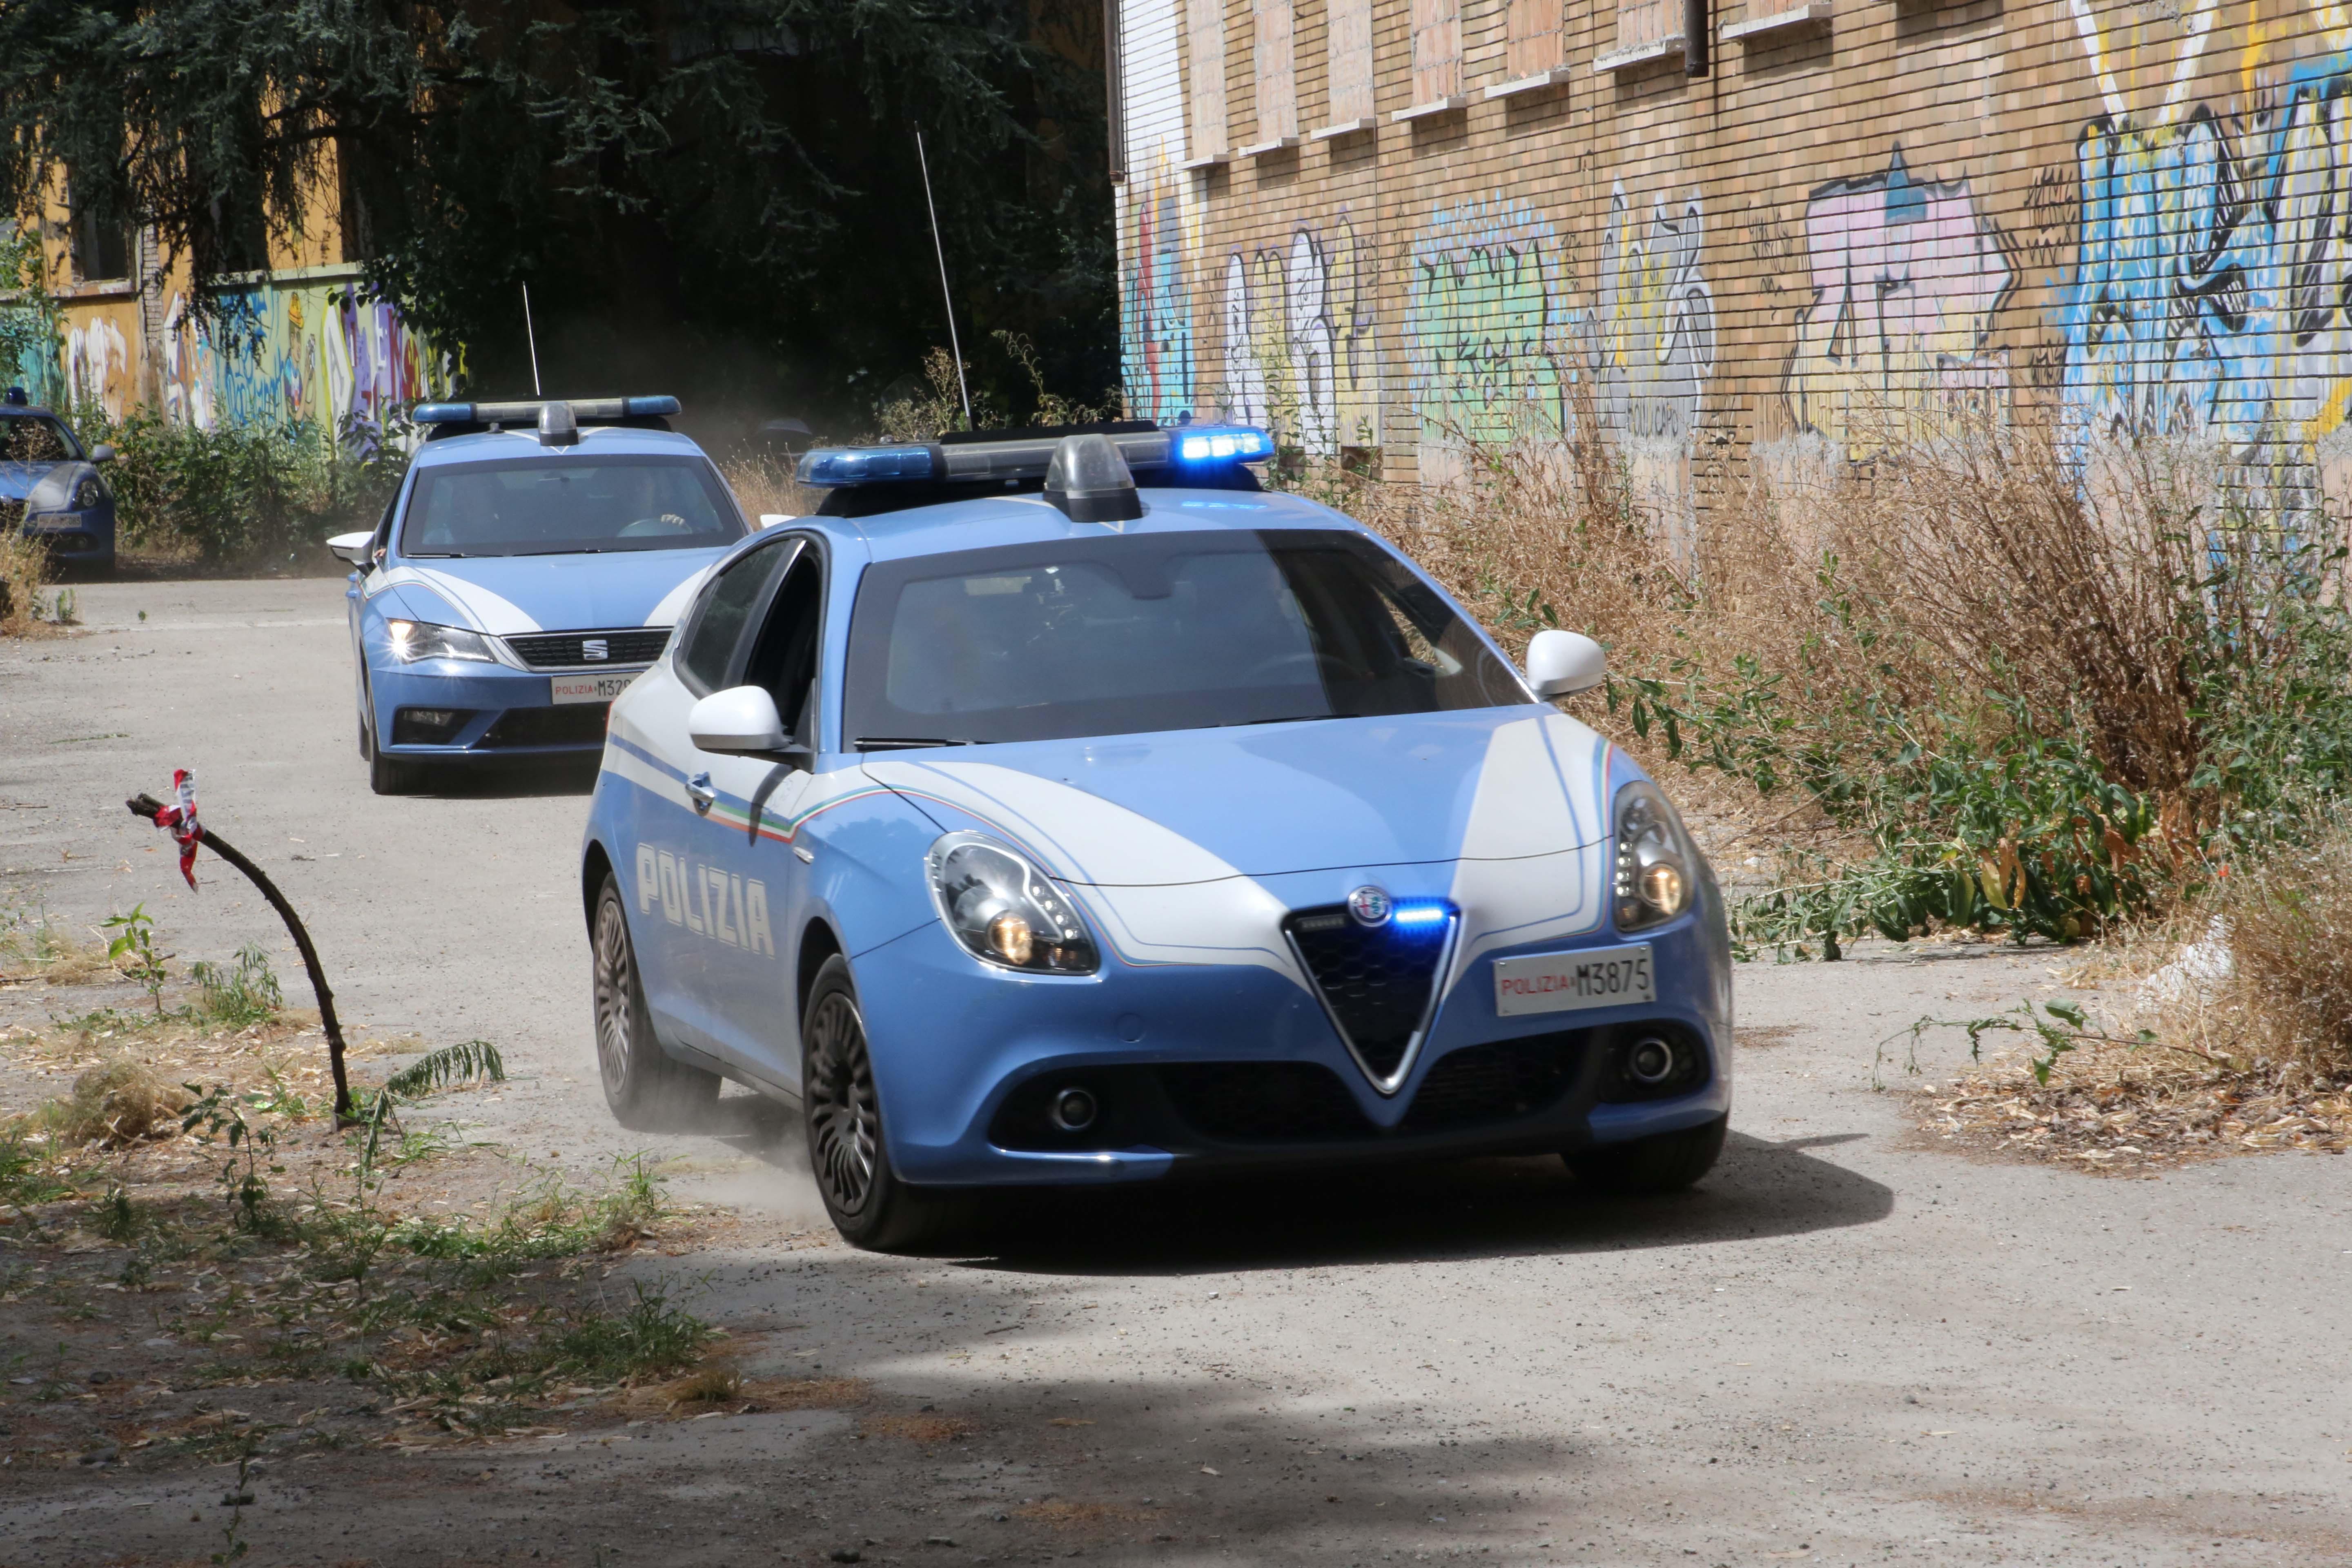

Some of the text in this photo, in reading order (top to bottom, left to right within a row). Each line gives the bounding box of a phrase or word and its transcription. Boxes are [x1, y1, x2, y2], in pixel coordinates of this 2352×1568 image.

[555, 685, 593, 695] POLIZIA
[636, 842, 775, 960] POLIZIA
[1501, 958, 1650, 996] POLIZIA M3875
